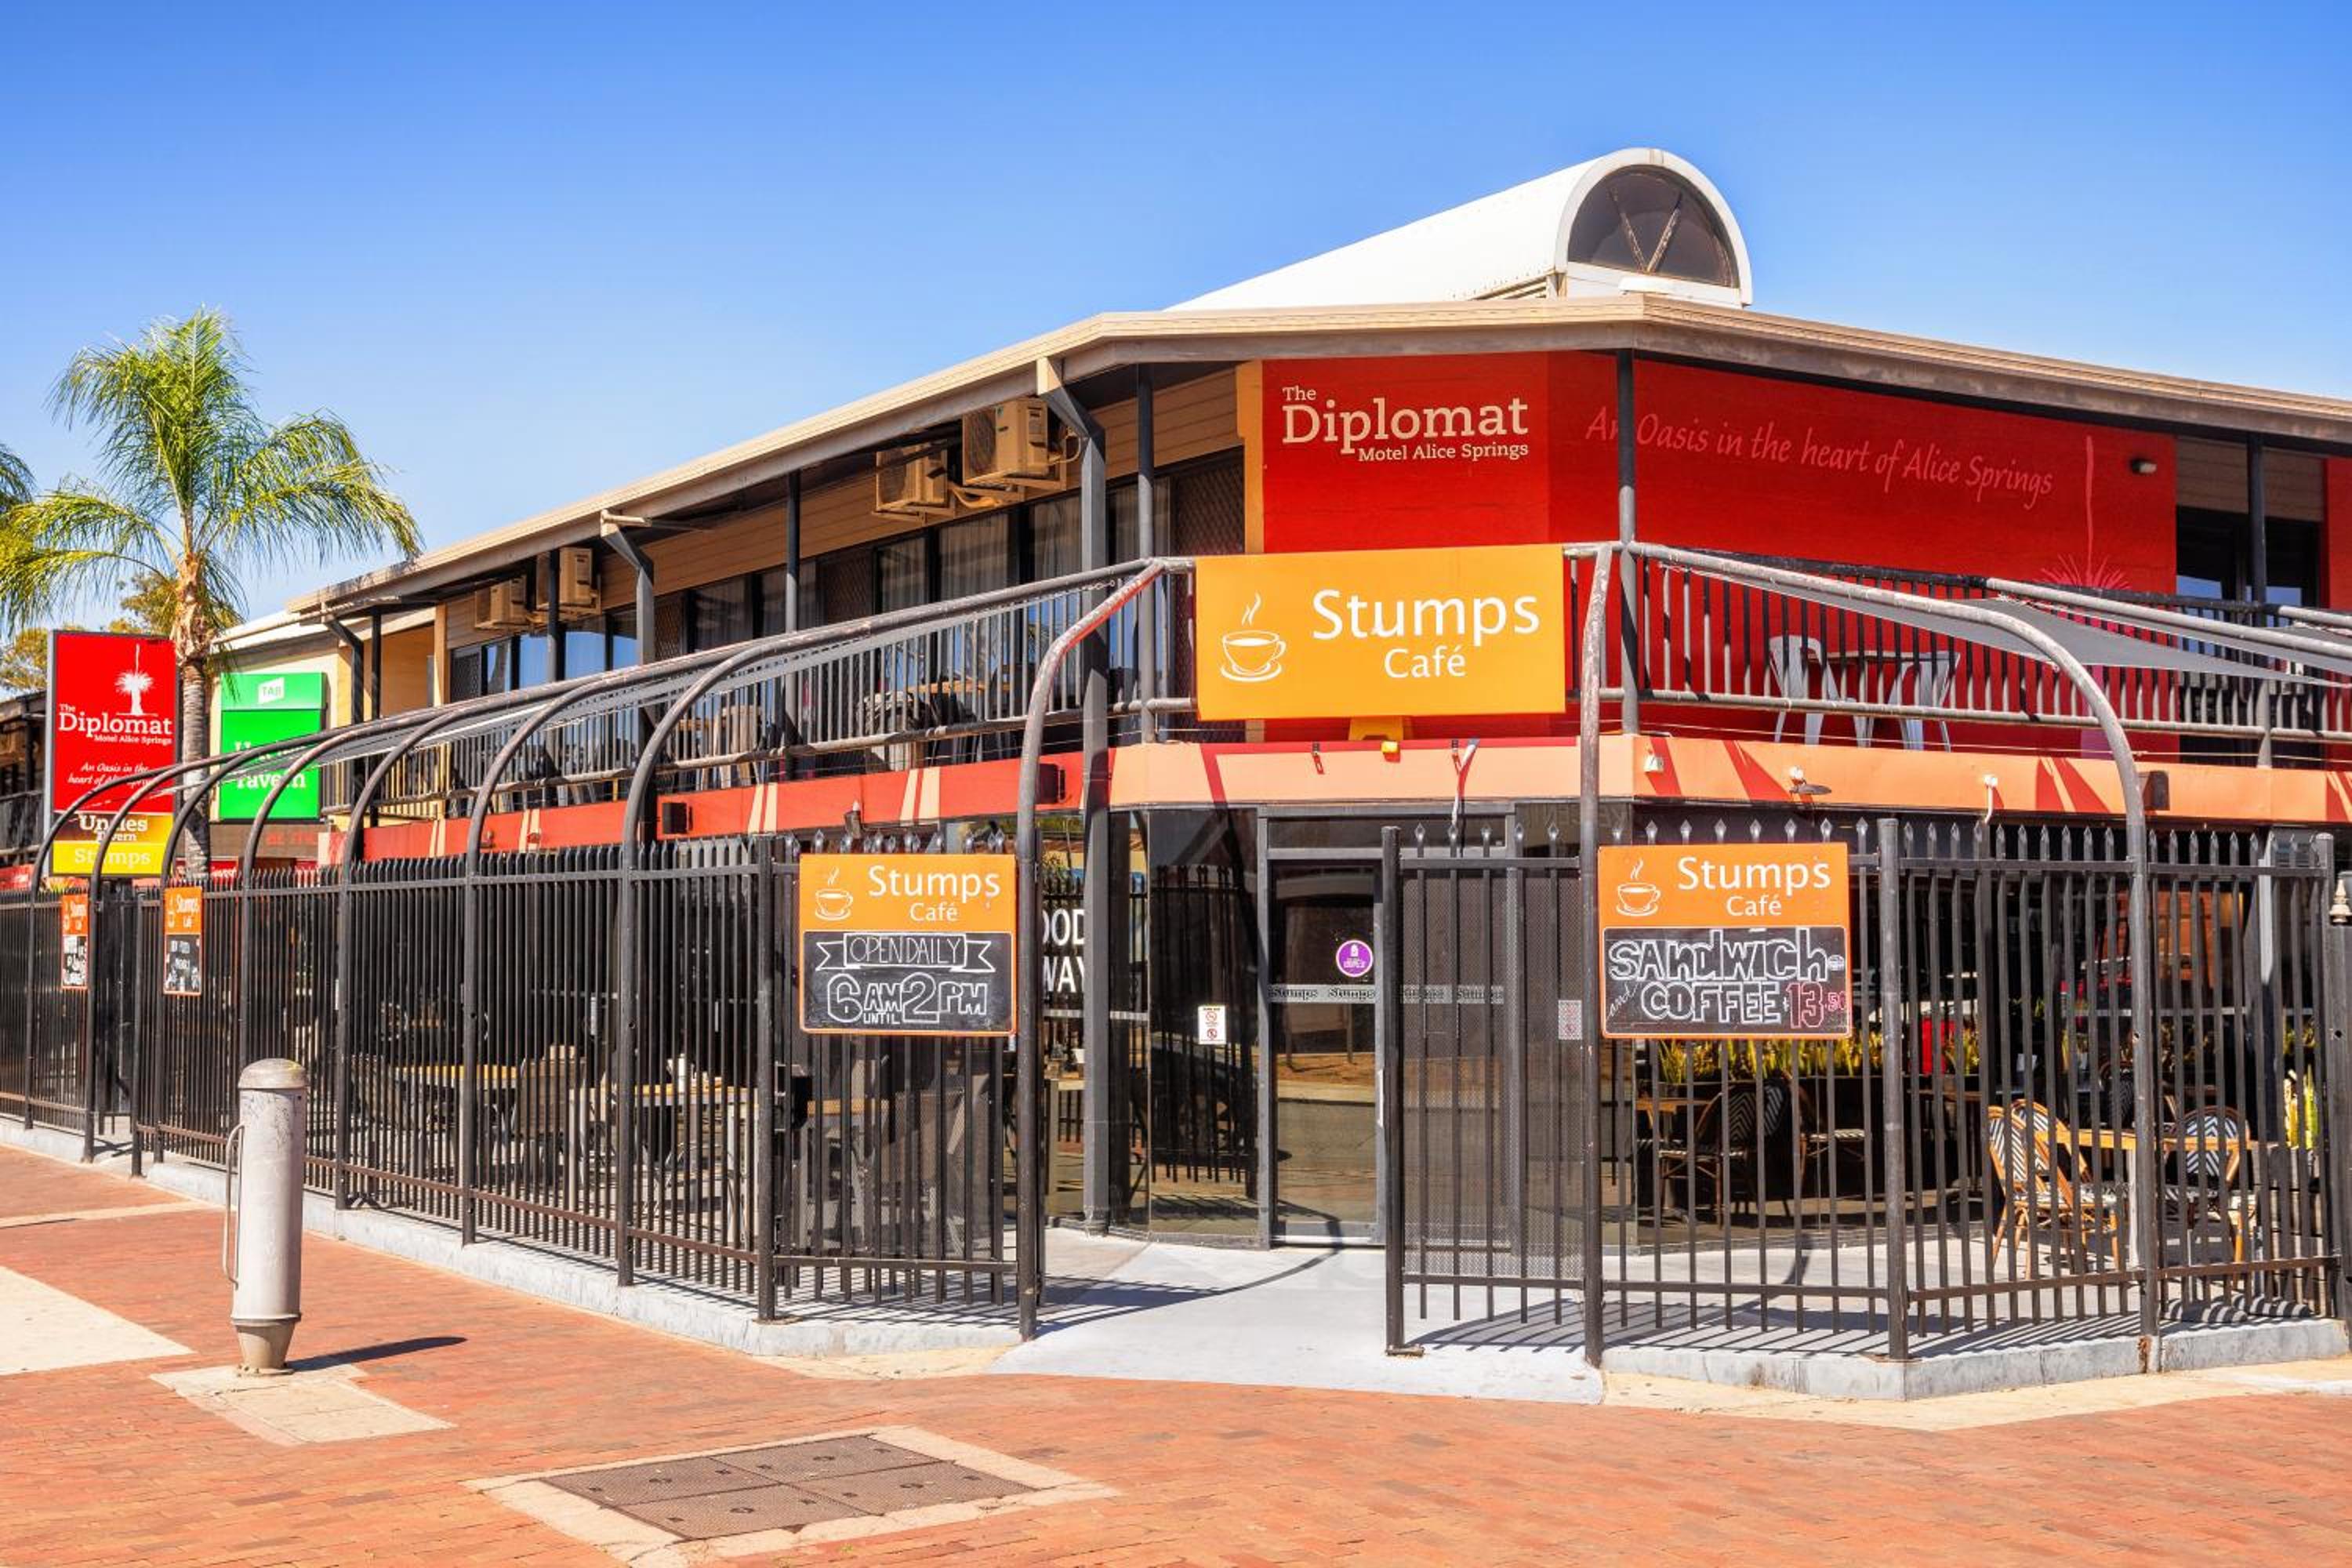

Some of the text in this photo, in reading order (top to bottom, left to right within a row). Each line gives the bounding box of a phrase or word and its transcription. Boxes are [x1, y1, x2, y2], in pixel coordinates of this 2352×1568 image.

[1282, 386, 1317, 401] The
[1282, 397, 1530, 455] Diplomat
[1358, 441, 1530, 463] Motel Alice Springs
[1636, 412, 1709, 452] Oasis
[1715, 425, 1743, 455] in
[1749, 420, 1793, 463] the
[1800, 427, 1871, 471] heart
[1875, 439, 1905, 492] of
[1905, 442, 1962, 482] Alice
[1964, 455, 2054, 510] Springs
[1311, 590, 1541, 648] Stumps
[1383, 644, 1468, 679] Café
[58, 712, 172, 738] Diplomat
[140, 737, 172, 746] Springs
[81, 763, 94, 771] An
[237, 772, 306, 789] aven
[79, 815, 147, 833] Unles
[96, 831, 136, 842] Tern
[74, 848, 151, 869] Stmps
[868, 865, 1001, 904] Stumps
[1678, 857, 1831, 897] Stumps
[909, 902, 959, 922] Café
[1726, 895, 1782, 917] Café
[849, 937, 962, 965] OPEN DAILY
[1641, 981, 1782, 1023] COFFEE
[863, 1012, 901, 1025] UNTIL
